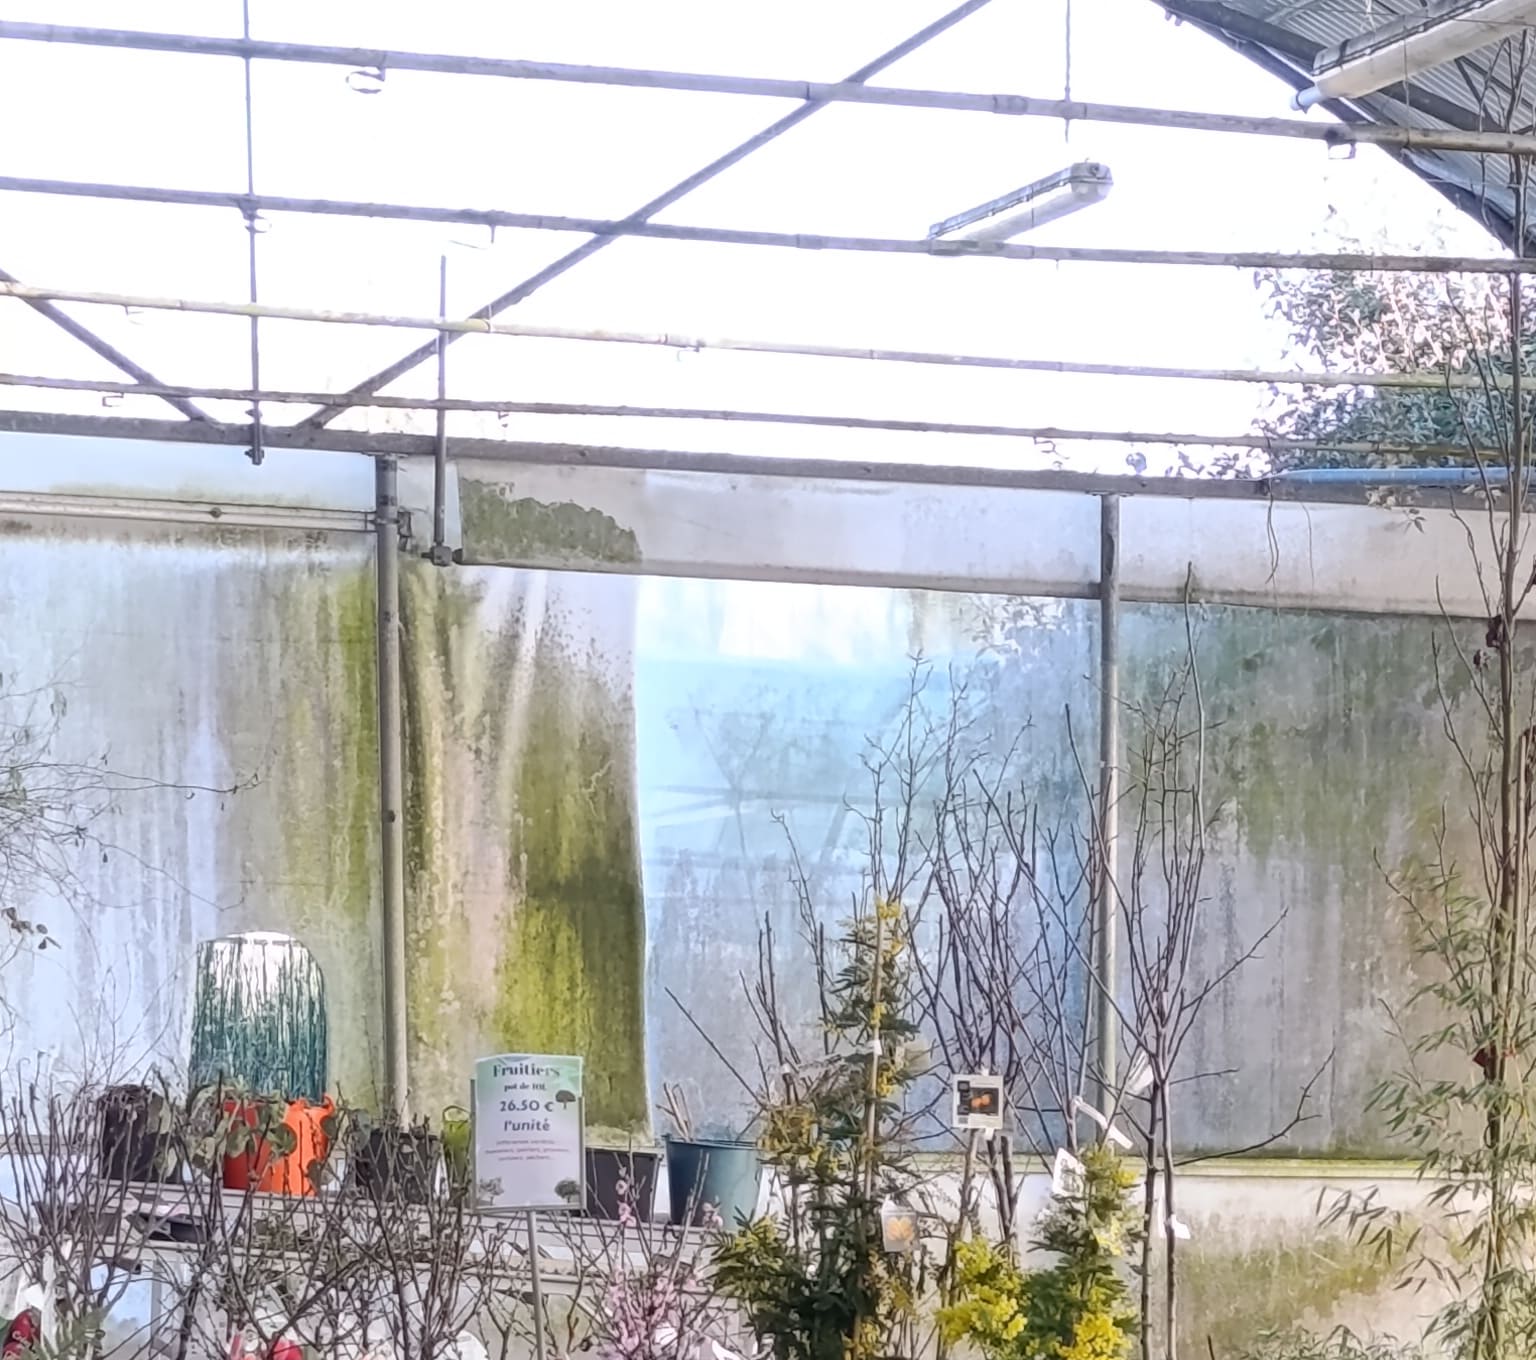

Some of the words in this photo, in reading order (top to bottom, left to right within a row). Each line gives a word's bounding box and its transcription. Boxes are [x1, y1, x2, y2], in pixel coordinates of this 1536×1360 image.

[493, 1063, 560, 1077] Fruitiers
[504, 1083, 517, 1092] pot
[519, 1082, 530, 1090] de
[500, 1099, 540, 1112] 26.50
[543, 1101, 554, 1112] €
[504, 1117, 551, 1131] l'unité
